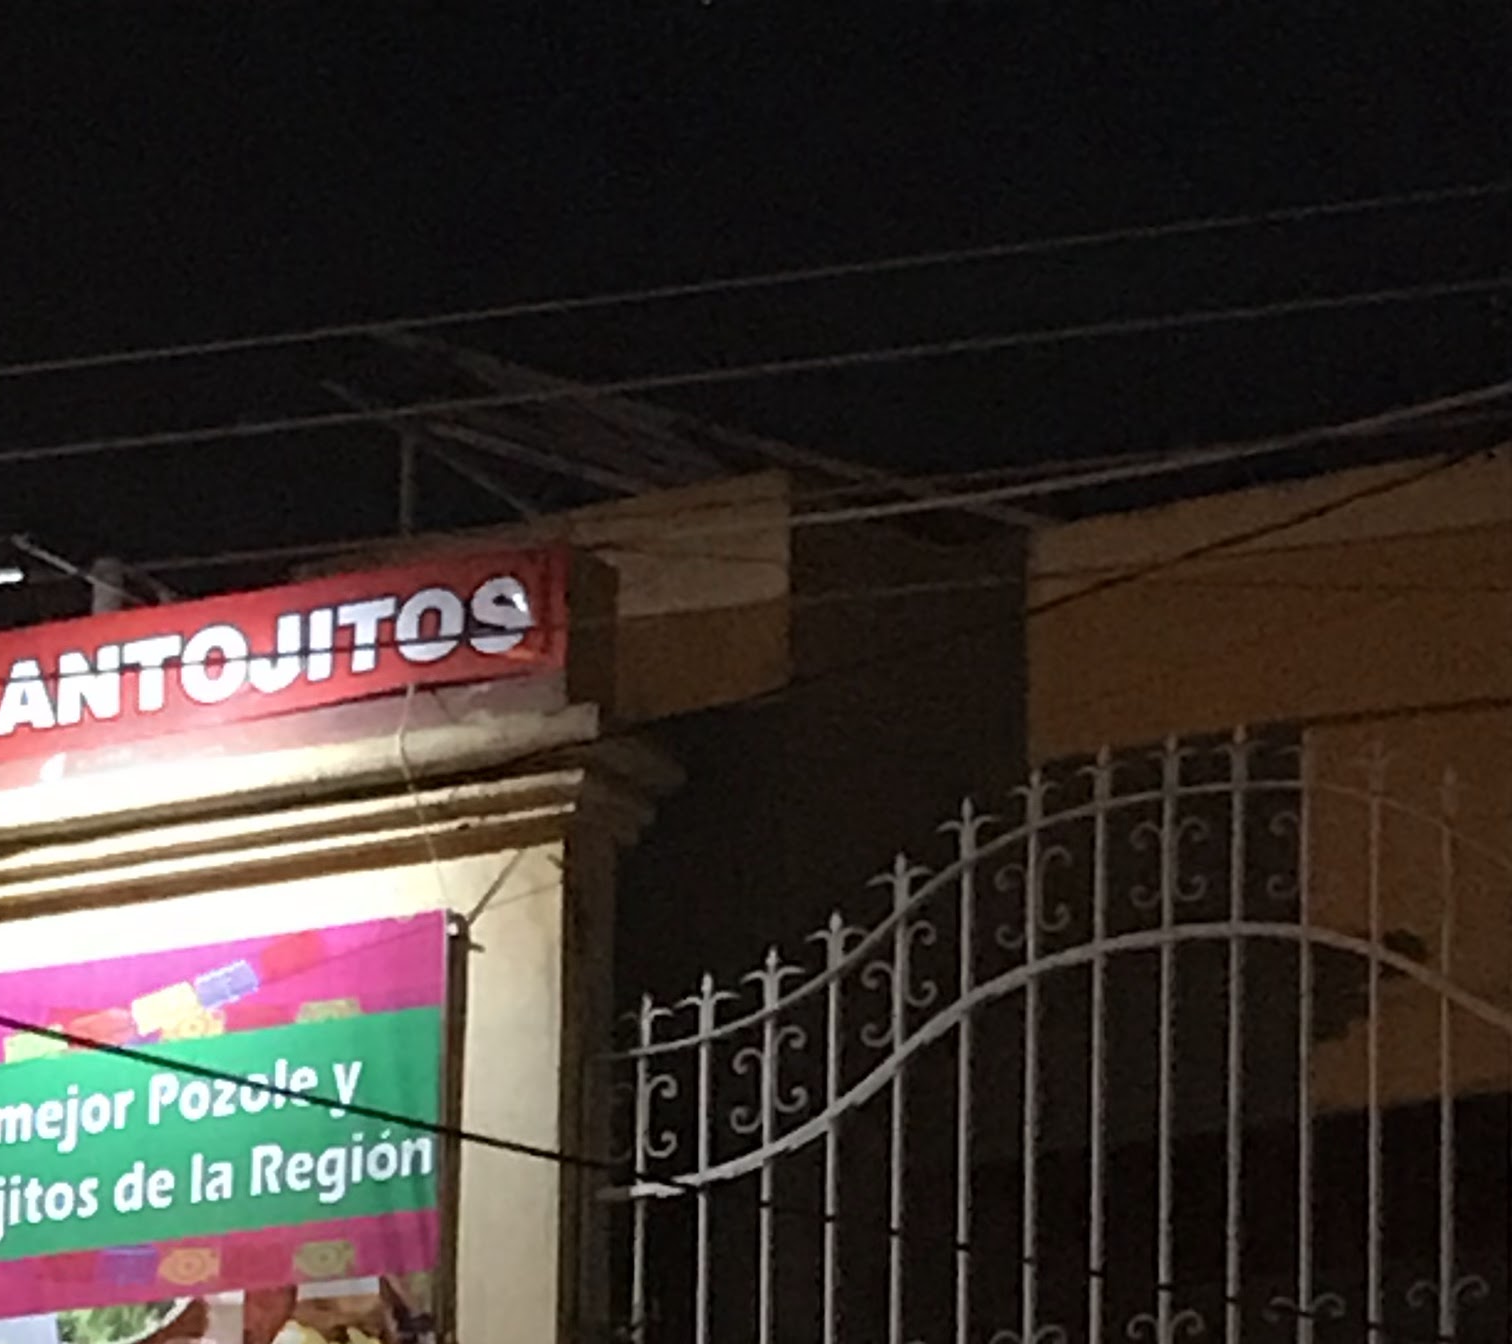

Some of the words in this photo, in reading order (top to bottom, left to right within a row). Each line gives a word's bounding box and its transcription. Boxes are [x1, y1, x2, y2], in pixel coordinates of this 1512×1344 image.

[149, 1058, 318, 1124] Pozole
[332, 1061, 361, 1117] y
[114, 1161, 175, 1213] de
[190, 1153, 233, 1203] la
[250, 1127, 432, 1205] Región
